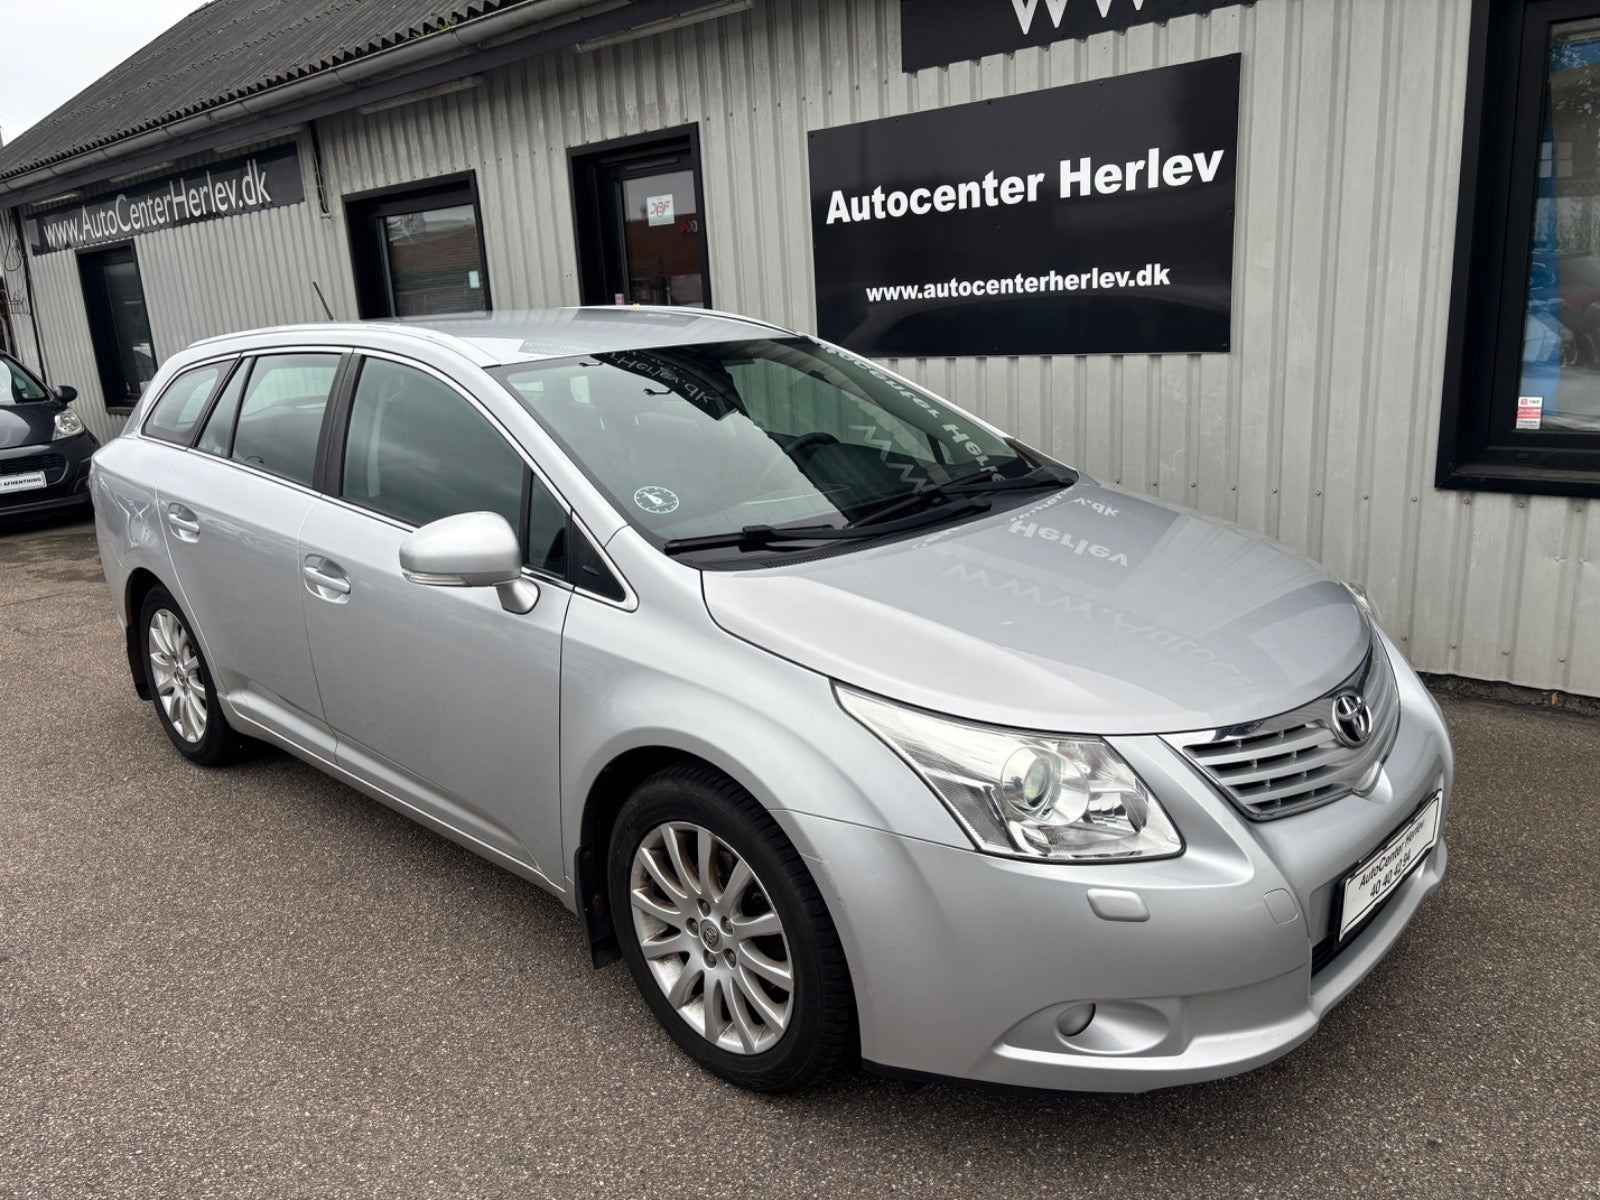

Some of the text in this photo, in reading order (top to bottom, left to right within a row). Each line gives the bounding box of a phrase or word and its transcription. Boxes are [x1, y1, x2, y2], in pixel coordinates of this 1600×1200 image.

[43, 158, 272, 248] www.AutoCenterHerlev.dk
[826, 146, 1225, 225] Autocenter Herlev
[866, 263, 1171, 302] www.autocenterherlev.dk
[1359, 842, 1405, 889] AutoCenter
